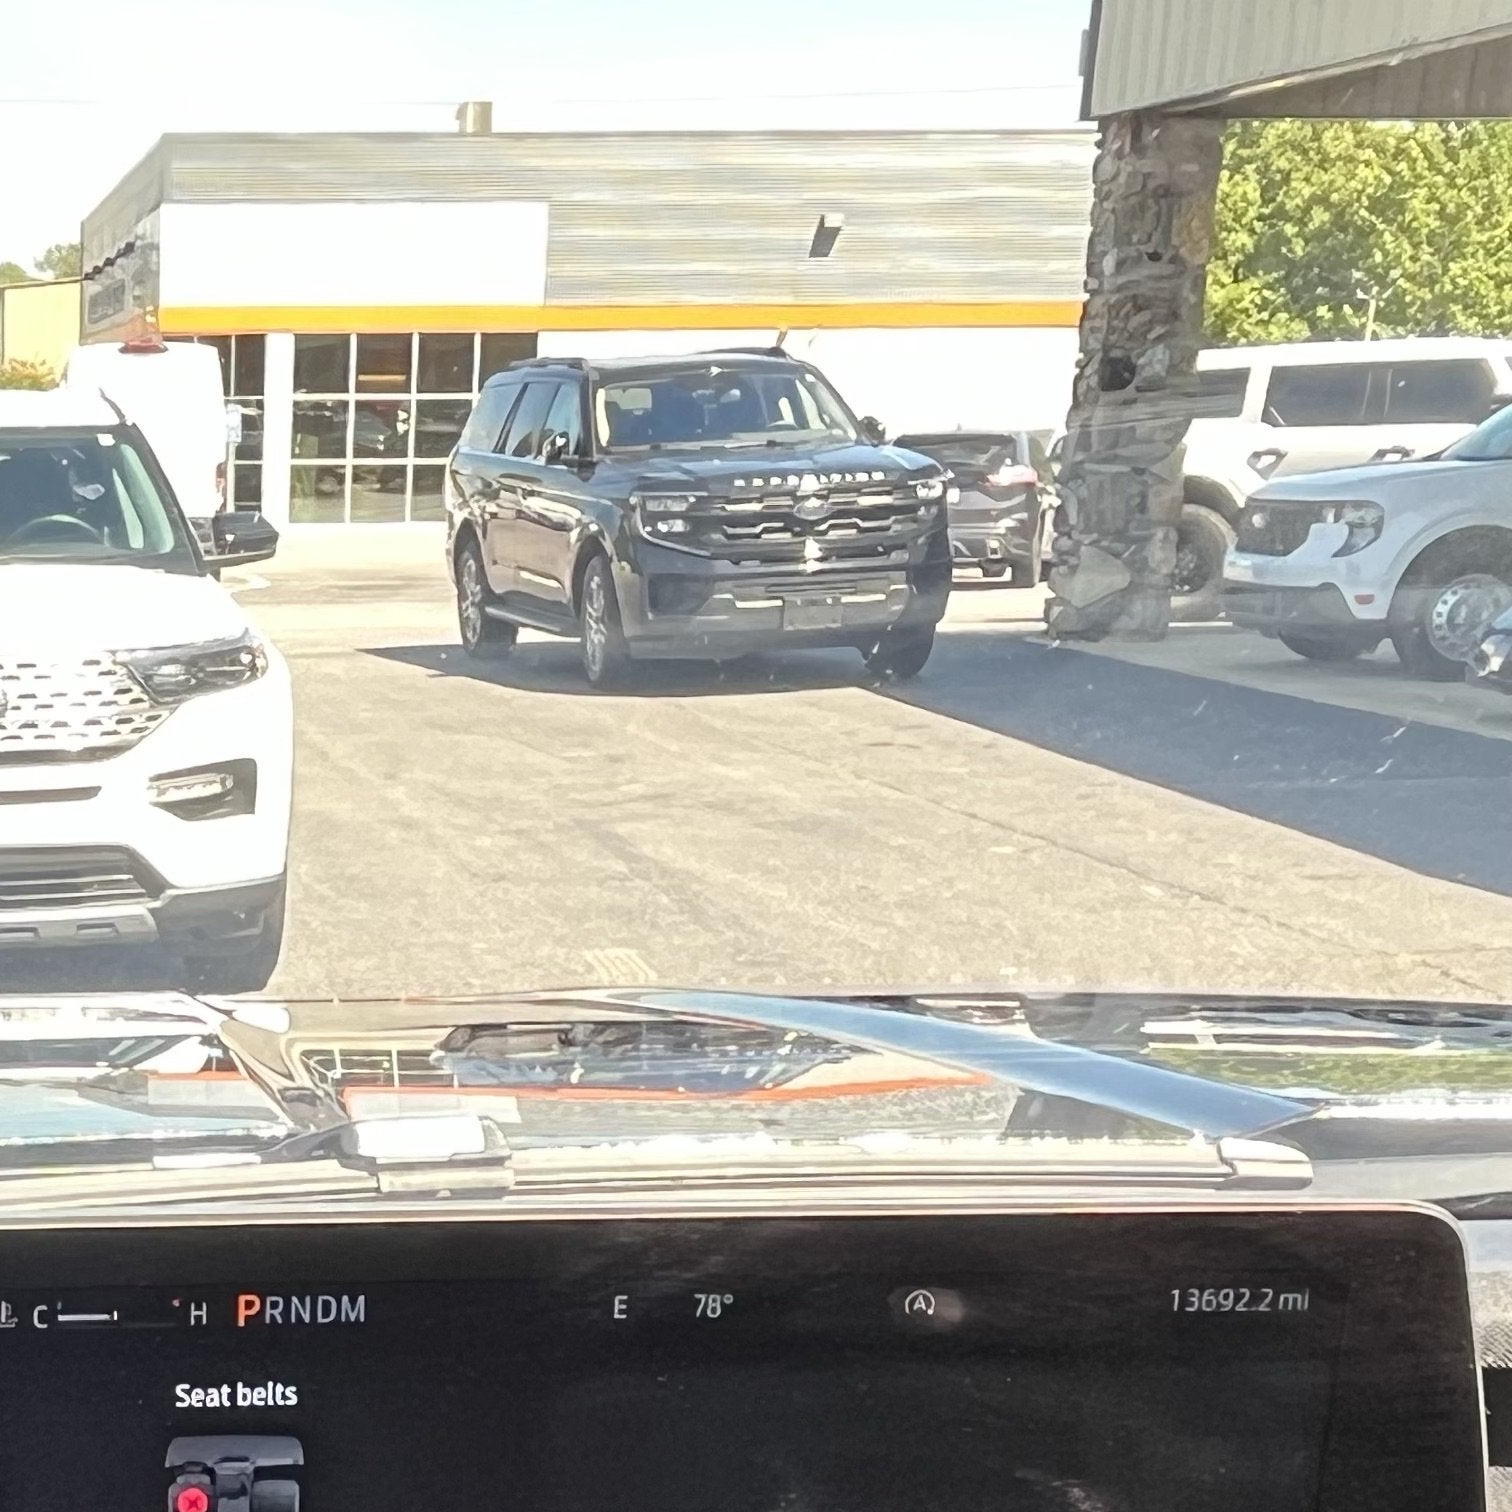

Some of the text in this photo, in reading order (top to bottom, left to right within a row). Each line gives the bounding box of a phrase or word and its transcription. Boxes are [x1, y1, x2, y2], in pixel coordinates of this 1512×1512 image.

[32, 1304, 48, 1329] C
[190, 1301, 208, 1326] H
[613, 1295, 629, 1319] E
[175, 1381, 298, 1408] Seat belts
